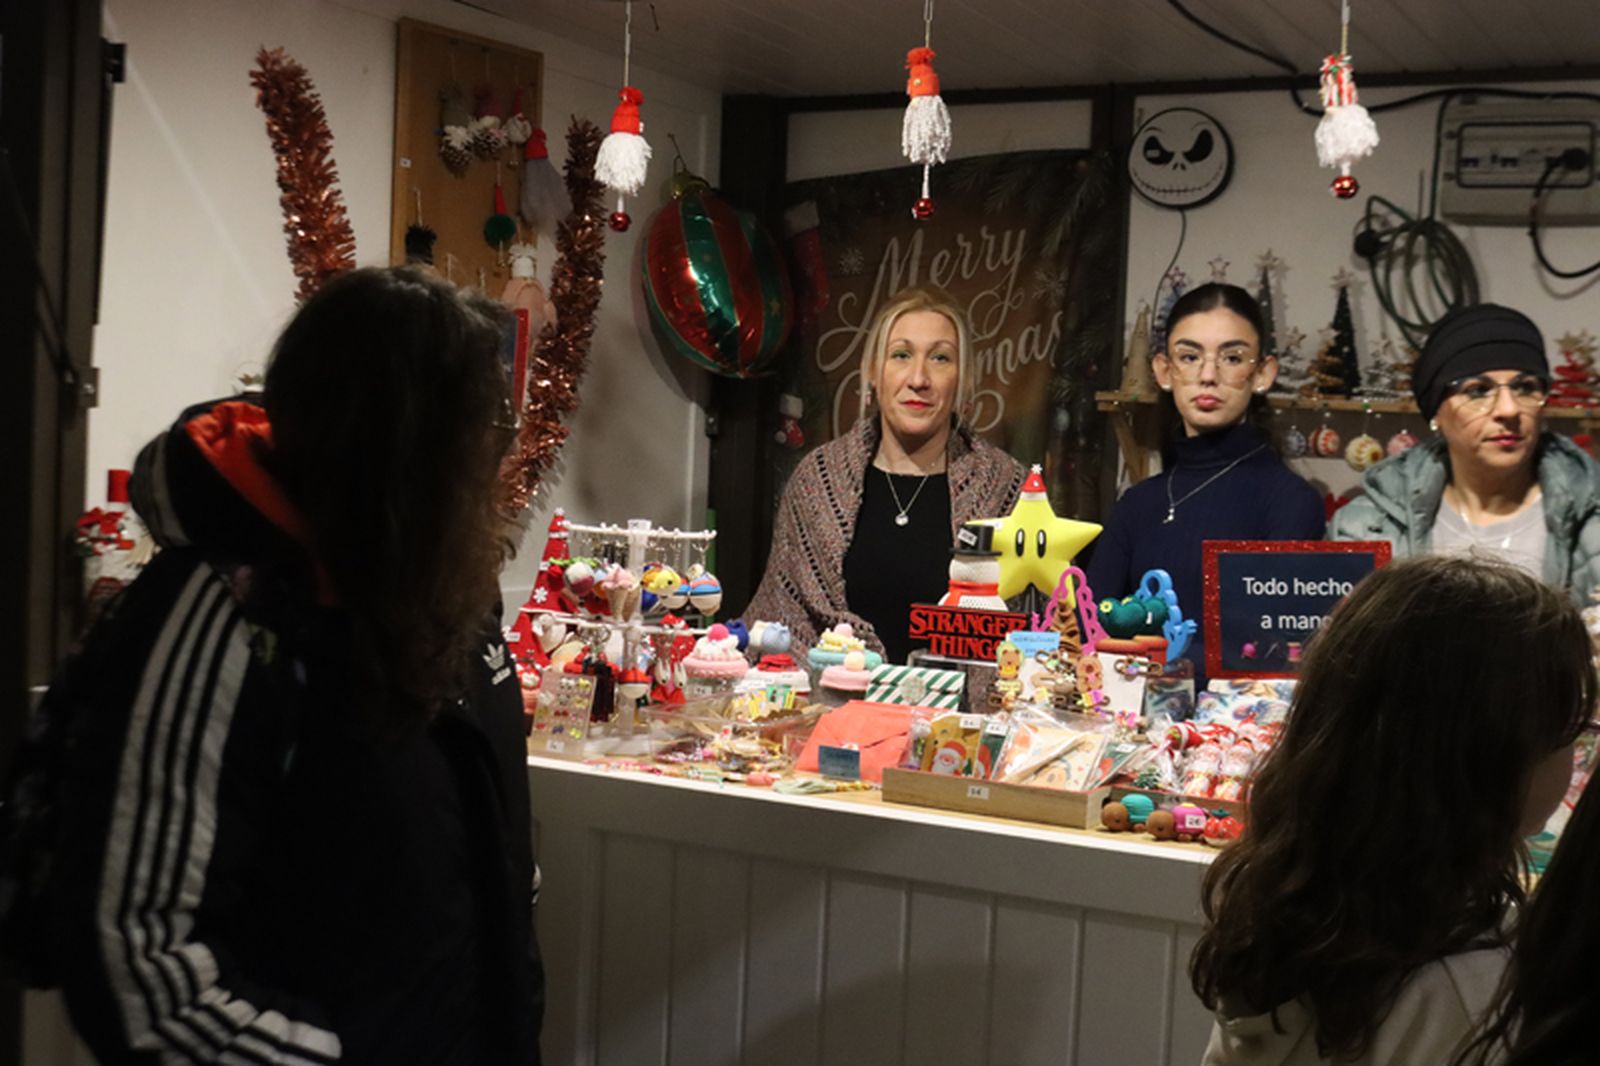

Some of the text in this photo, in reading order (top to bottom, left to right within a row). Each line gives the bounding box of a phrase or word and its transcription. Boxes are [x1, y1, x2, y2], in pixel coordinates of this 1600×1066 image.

[816, 226, 1026, 373] Merry
[1242, 577, 1353, 597] Todo hecho
[908, 608, 1028, 638] STRANGER
[1260, 614, 1272, 629] a
[927, 634, 998, 661] THING
